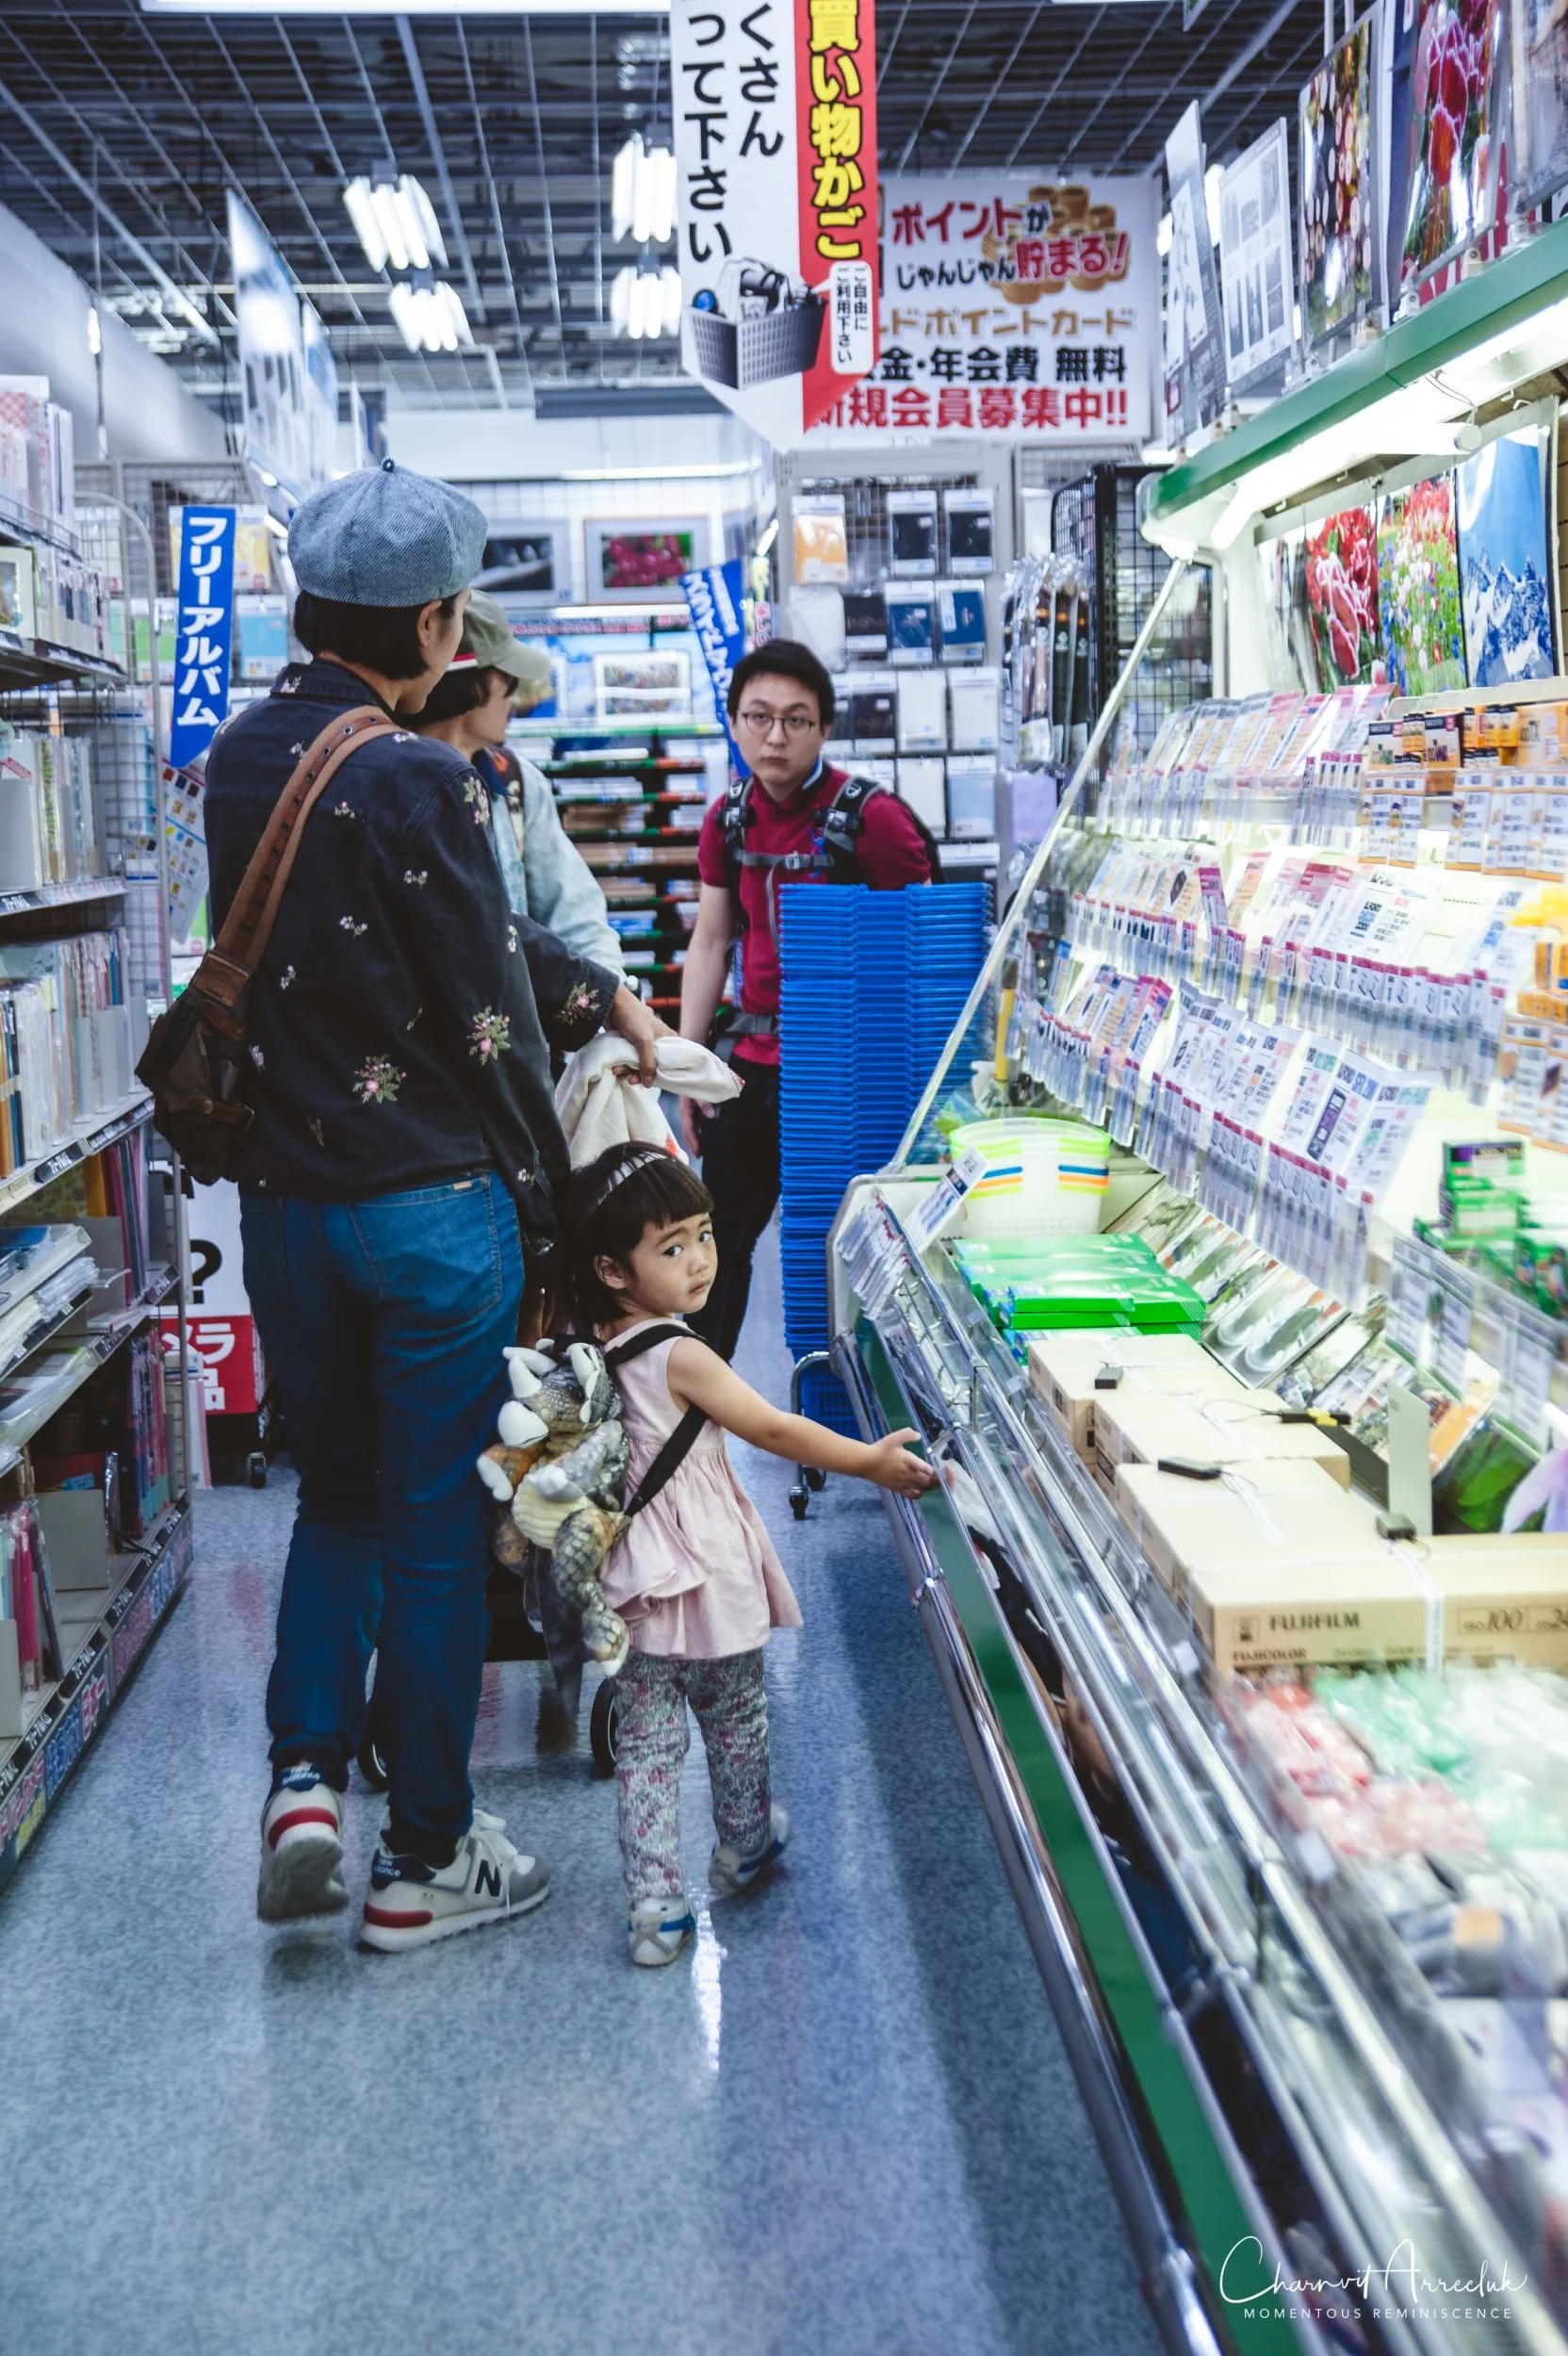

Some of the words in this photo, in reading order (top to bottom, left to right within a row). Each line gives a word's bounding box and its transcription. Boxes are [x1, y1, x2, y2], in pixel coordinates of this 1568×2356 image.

[739, 3, 784, 157] くさん
[682, 13, 732, 263] って下さい
[808, 0, 866, 260] 買い物かご
[891, 197, 1051, 247] ポイントが
[836, 266, 853, 364] ご利用下さい
[854, 266, 868, 332] ご自由に
[880, 307, 1134, 337] ドポイントカード
[864, 346, 1040, 383] 金・年会費
[1055, 345, 1127, 383] 無料
[176, 515, 228, 727] フリーアルバム
[1269, 1612, 1360, 1631] FUJIFILM
[1488, 1608, 1524, 1631] 100
[1233, 1646, 1307, 1661] FUJICOLOR
[474, 1859, 501, 1897] N
